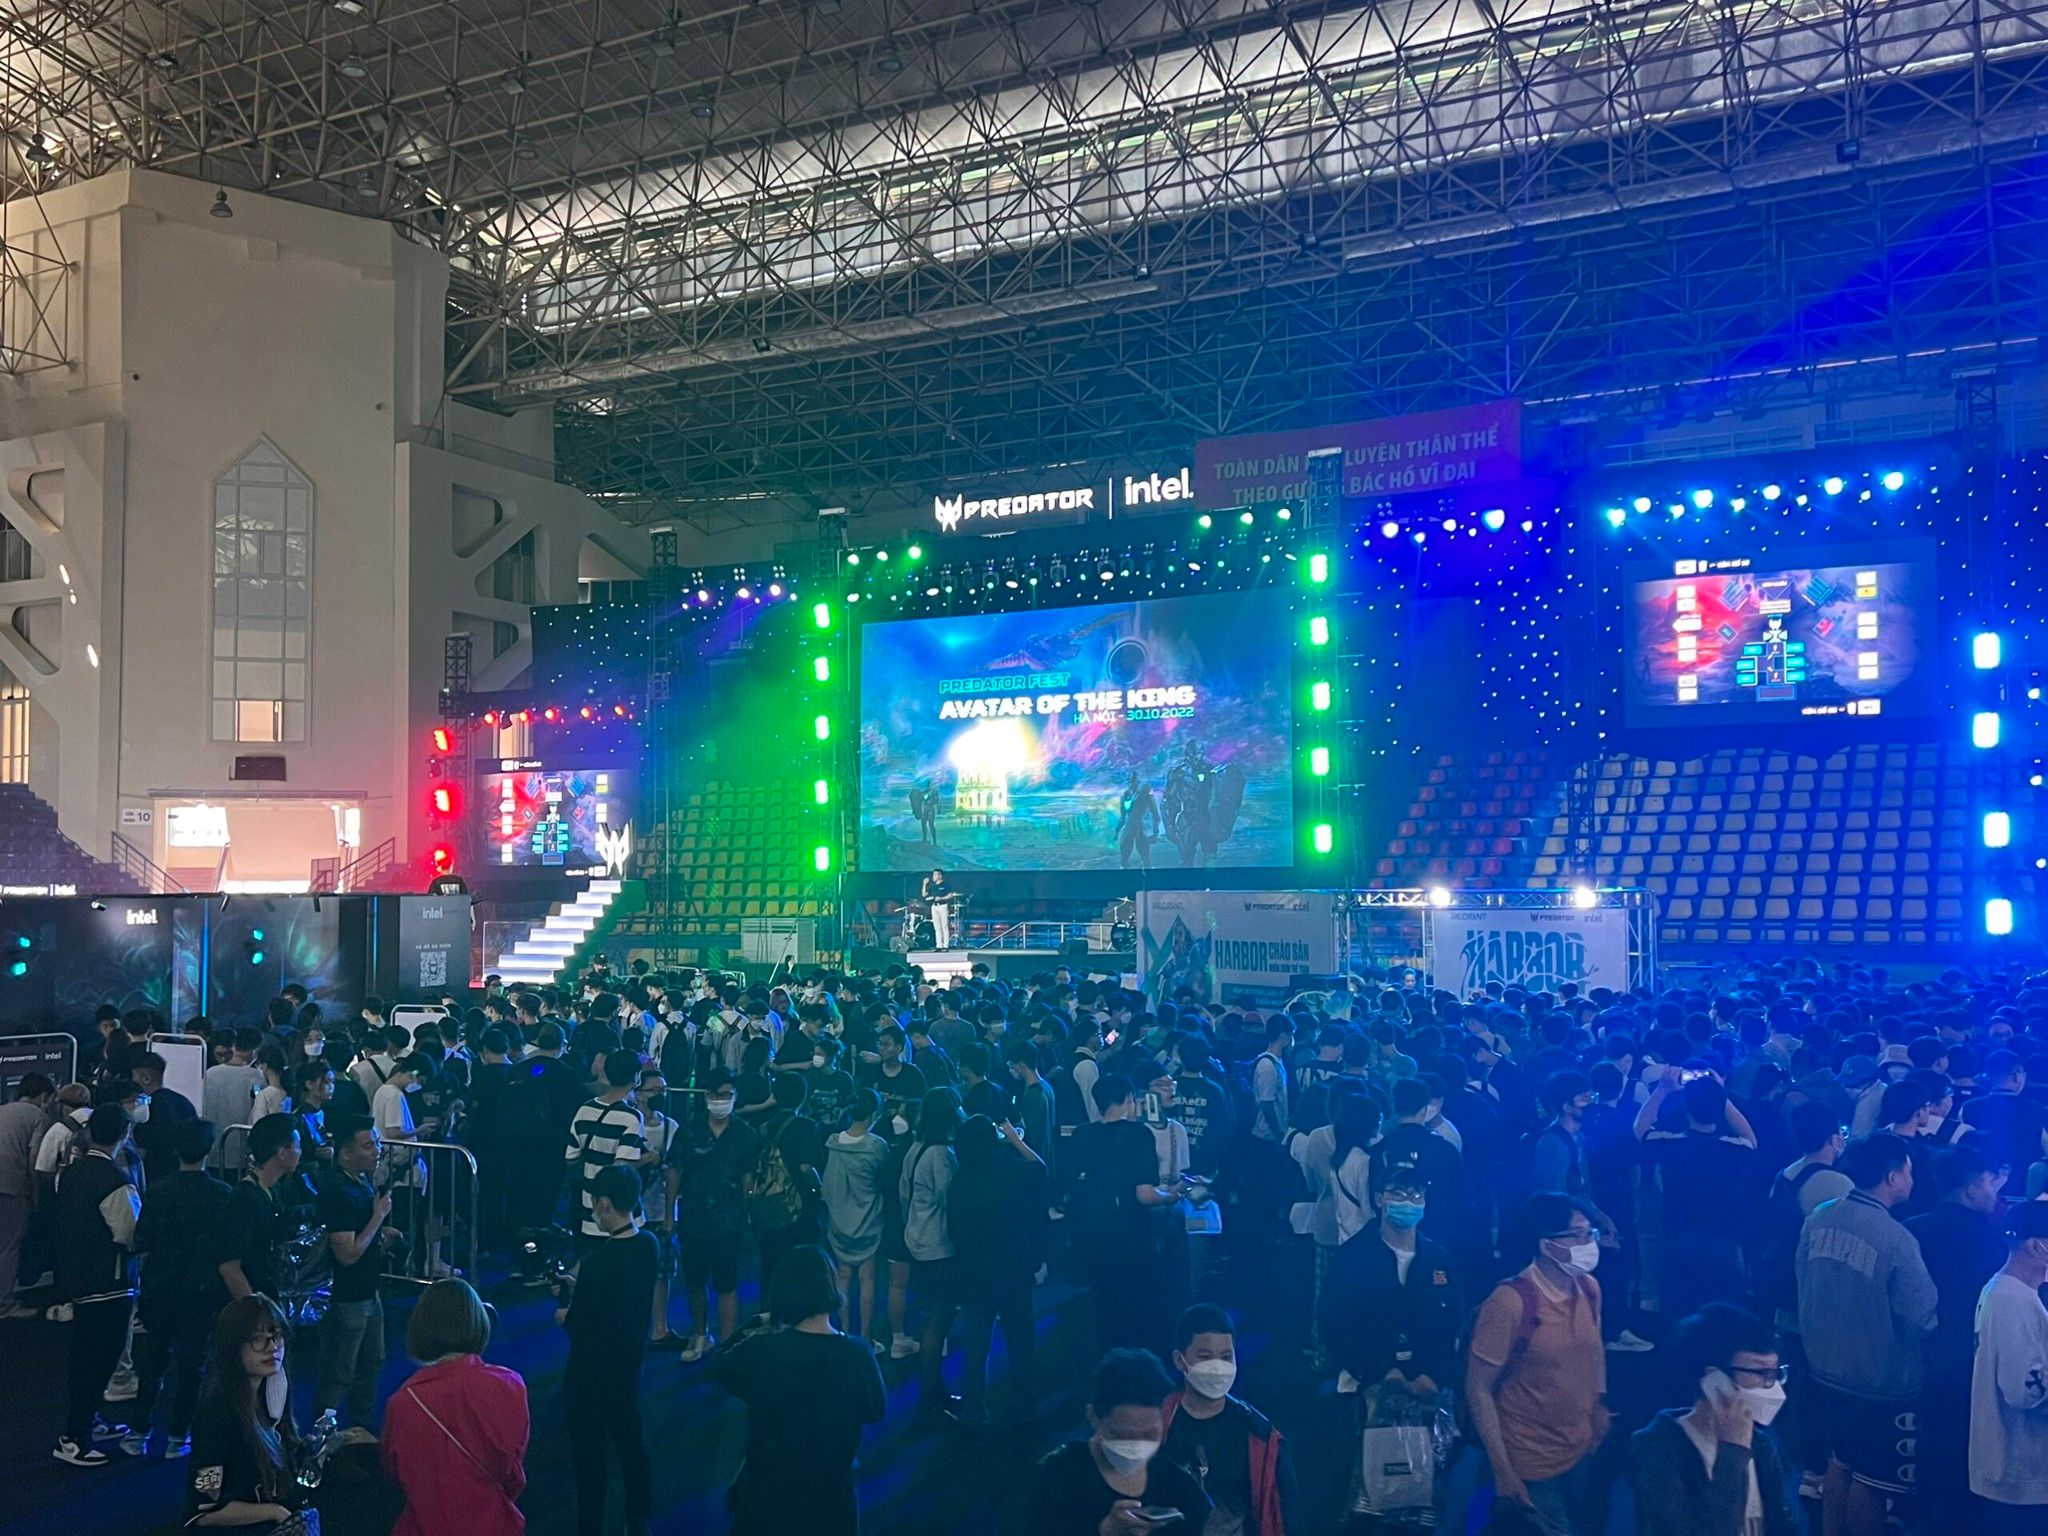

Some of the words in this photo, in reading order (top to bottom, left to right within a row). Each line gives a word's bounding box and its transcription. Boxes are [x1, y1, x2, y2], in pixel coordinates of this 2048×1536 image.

[1216, 457, 1258, 480] TOÀN
[1264, 455, 1300, 475] DÂN
[1344, 442, 1400, 468] LUYỆN
[1406, 434, 1457, 459] THÂN
[1233, 486, 1277, 505] THEO
[1350, 473, 1385, 494] BÁC
[1420, 461, 1440, 484] VĨ
[1443, 461, 1477, 485] ĐẠI
[964, 488, 1094, 520] PREDATOR
[940, 675, 1027, 694] PREDATOR
[1028, 671, 1071, 689] FEST
[939, 697, 1034, 719] AVATAR
[1036, 693, 1071, 714] OF
[1073, 690, 1123, 712] THE
[1126, 685, 1197, 709] KING
[1126, 706, 1195, 721] 30.10.2022
[137, 812, 151, 822] 10
[1215, 940, 1268, 971] HARBOR
